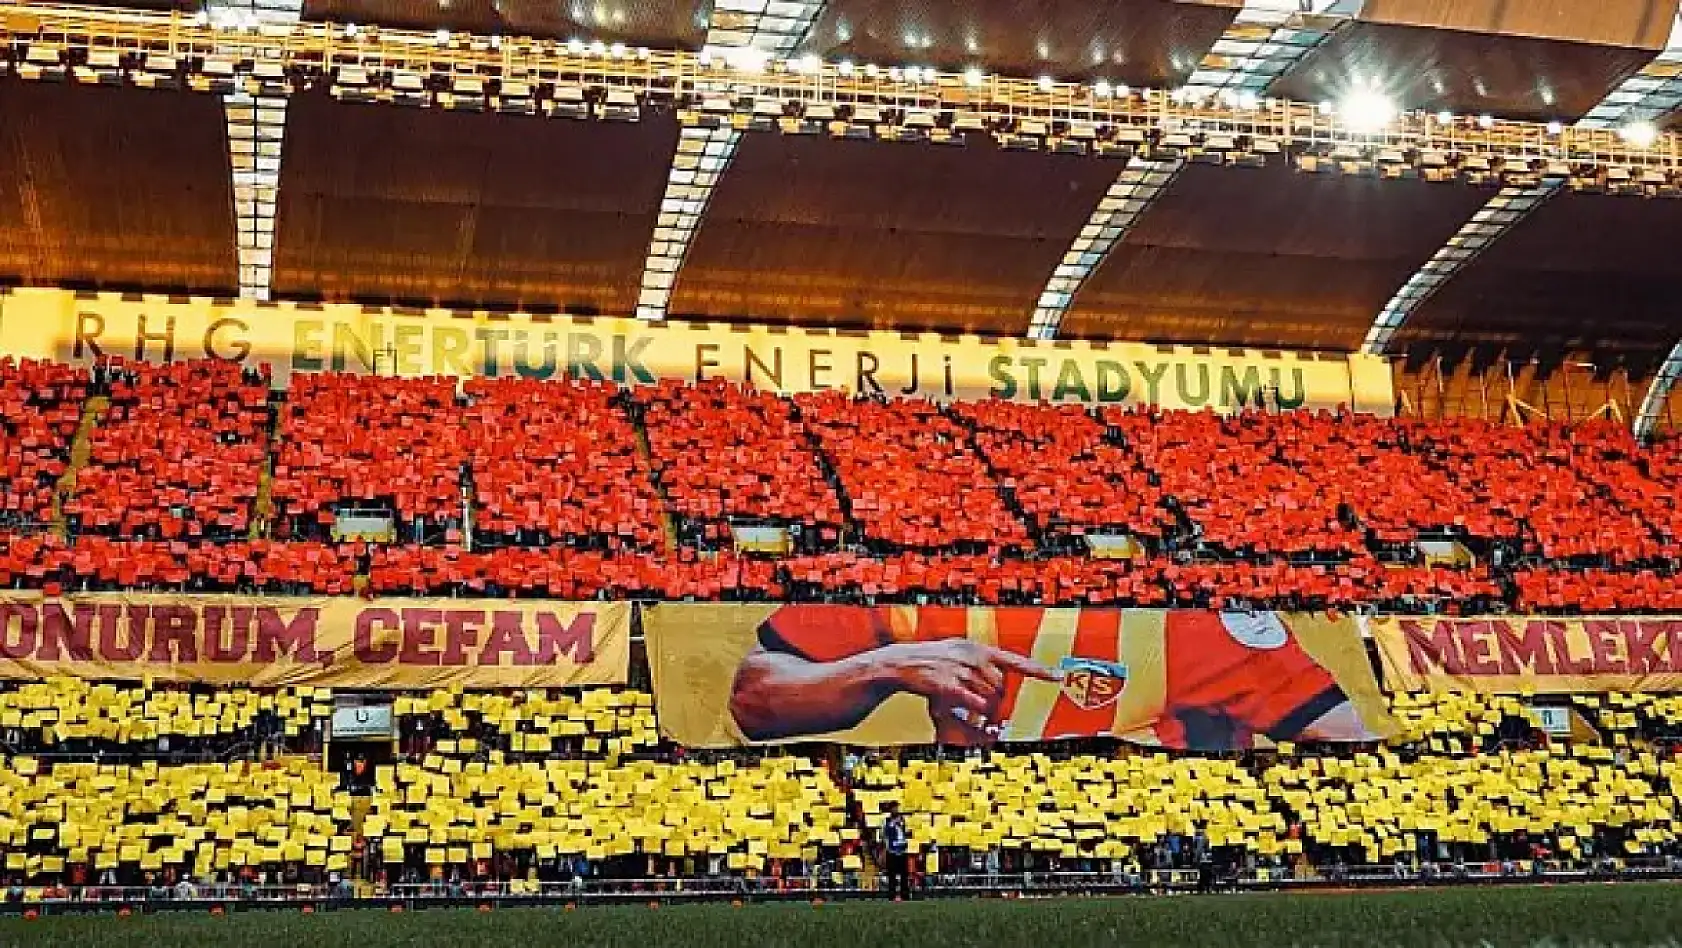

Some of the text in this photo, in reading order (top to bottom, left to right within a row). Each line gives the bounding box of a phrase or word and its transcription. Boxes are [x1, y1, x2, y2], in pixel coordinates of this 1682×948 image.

[291, 321, 656, 383] ENERTÜRK
[988, 356, 1305, 409] STADYUMU
[353, 607, 597, 666] CEFAM
